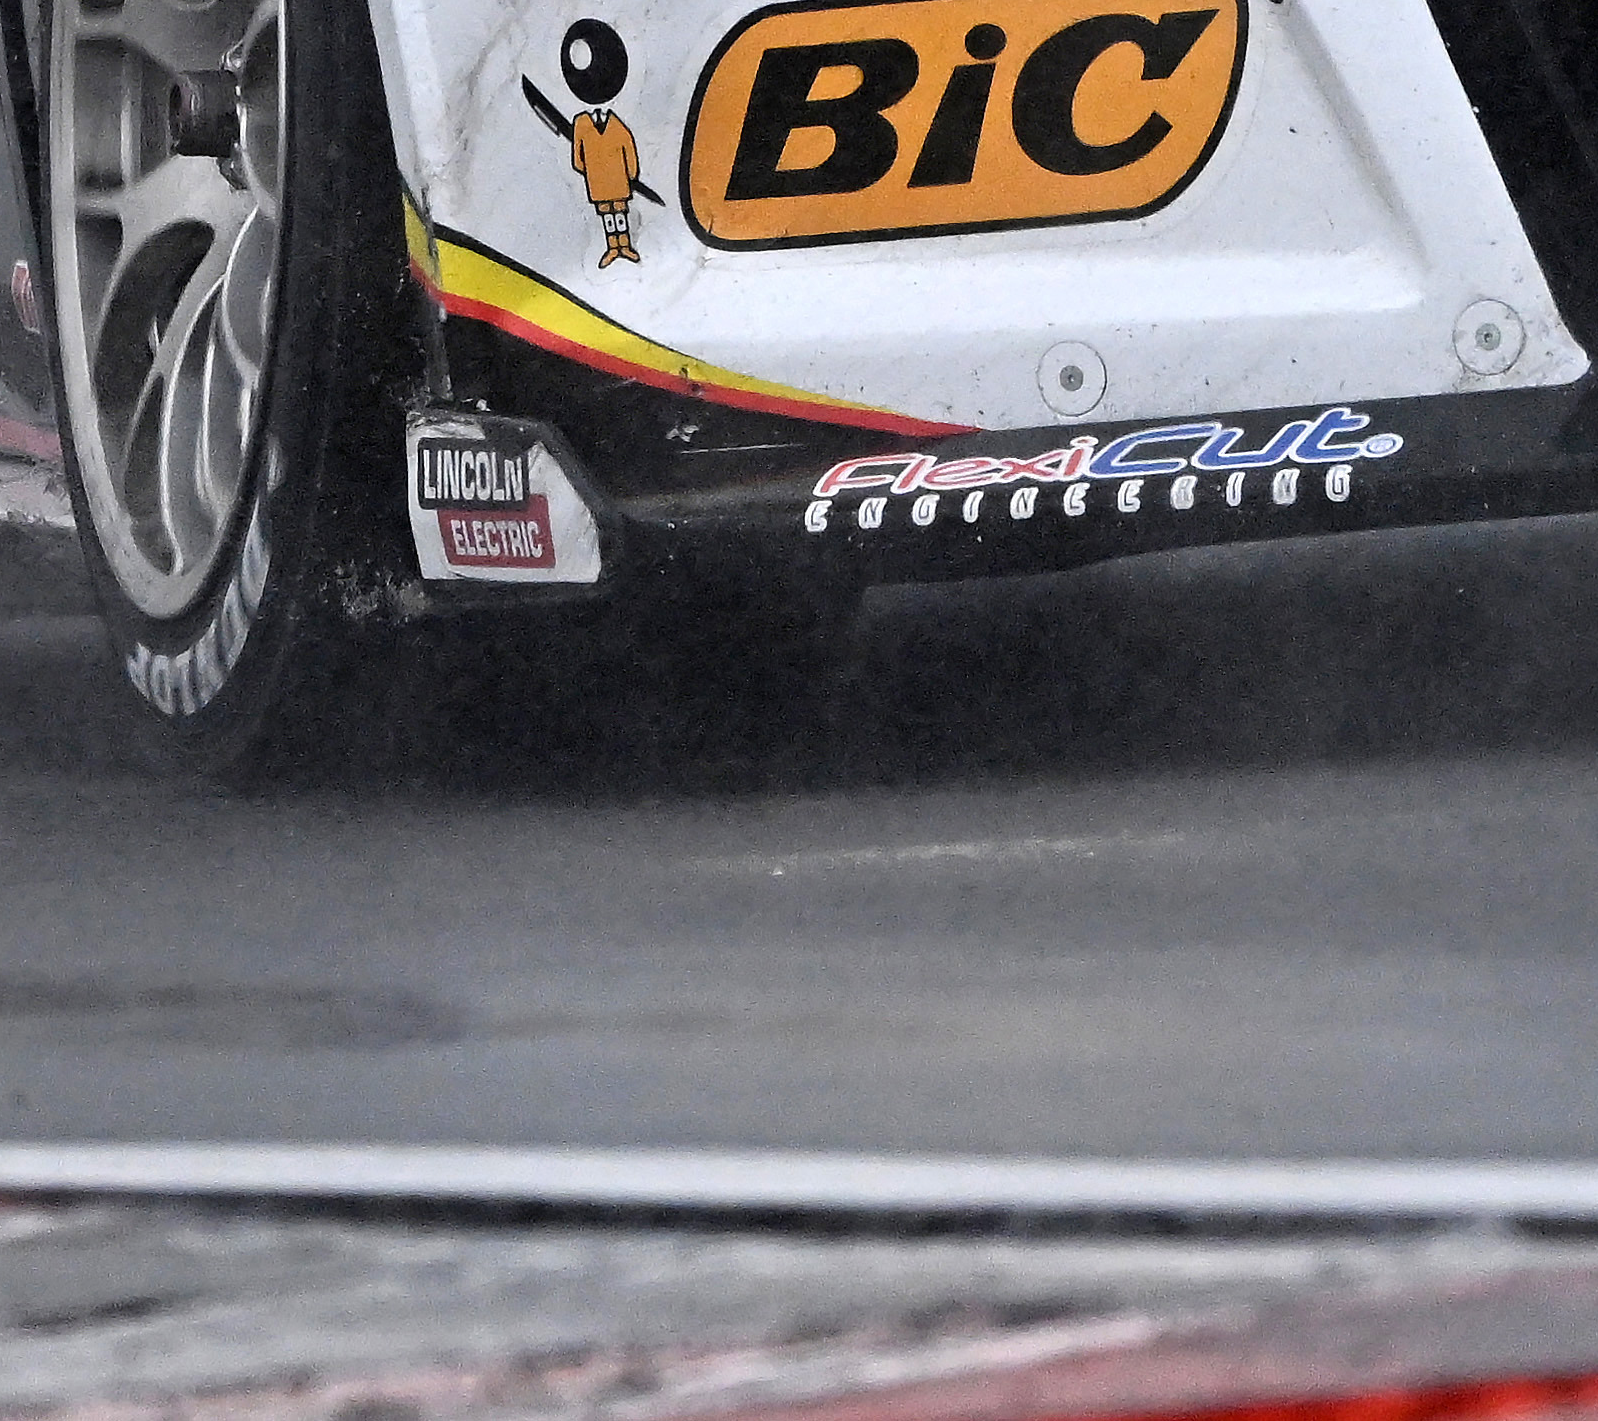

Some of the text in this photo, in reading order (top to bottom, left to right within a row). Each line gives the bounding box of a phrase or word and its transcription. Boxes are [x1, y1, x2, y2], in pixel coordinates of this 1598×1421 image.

[421, 449, 525, 503] LINCOLN
[804, 464, 1353, 533] ENGINEERING
[448, 517, 545, 563] ELECTRIC
